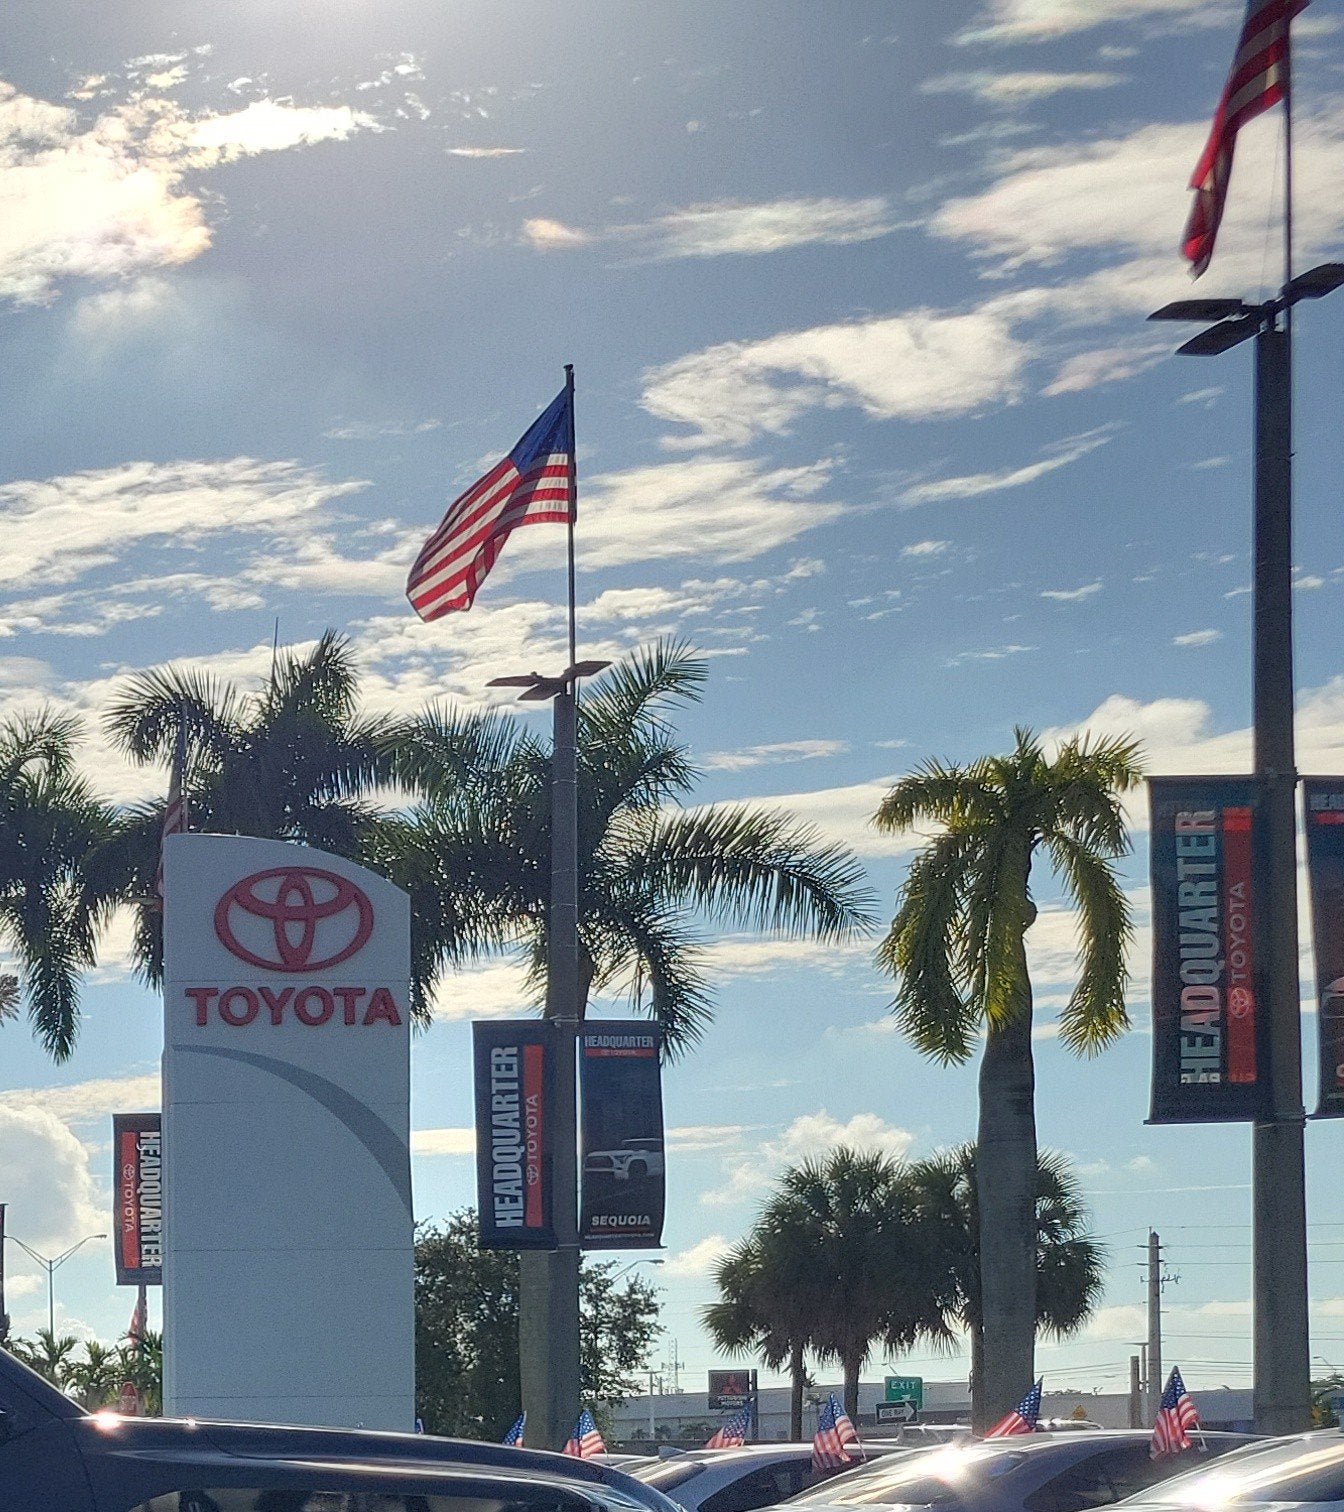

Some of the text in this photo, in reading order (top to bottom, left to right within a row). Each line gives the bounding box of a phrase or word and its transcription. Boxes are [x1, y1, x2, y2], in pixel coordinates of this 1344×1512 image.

[1175, 810, 1225, 1084] HEADQUARTER
[1229, 882, 1246, 983] TOYOTA
[184, 986, 403, 1027] TOYOTA
[585, 1036, 654, 1048] HEADQUARTER
[491, 1046, 525, 1228] HEADQUARTER
[525, 1094, 539, 1161] TOYOTA
[124, 1182, 135, 1233] TOYOTA
[137, 1131, 162, 1268] HEADQUARTER
[591, 1215, 651, 1227] SEQUOIA
[891, 1381, 916, 1389] EXIT
